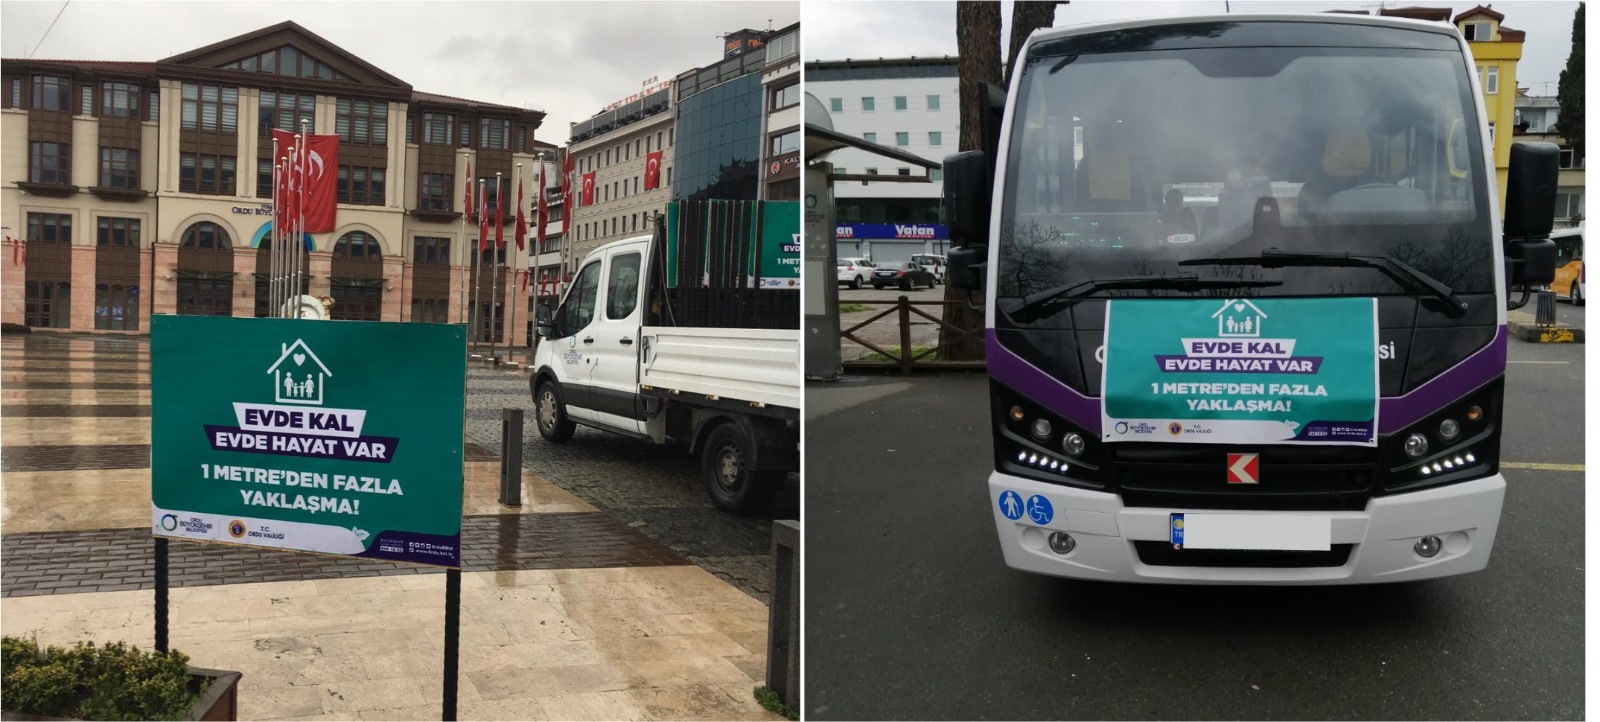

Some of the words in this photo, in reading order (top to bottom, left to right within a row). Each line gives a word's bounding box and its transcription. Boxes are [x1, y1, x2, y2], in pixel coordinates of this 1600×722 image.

[785, 157, 800, 165] KAL
[232, 206, 253, 215] ORDU
[836, 226, 853, 235] an
[895, 225, 935, 235] Vatan
[1192, 342, 1243, 354] EVDE
[1248, 342, 1286, 354] KAL
[1380, 341, 1395, 359] Sİ
[1165, 359, 1212, 370] EVDE
[1215, 359, 1273, 371] HAYAT
[1276, 360, 1313, 372] VAR
[1151, 383, 1159, 394] 1
[1163, 383, 1264, 395] METRE'DEN
[1269, 384, 1328, 396] FAZLA
[1186, 400, 1292, 413] YAKLAŞMA!
[245, 408, 303, 429] EVDE
[309, 412, 354, 432] KAL
[216, 431, 268, 450] EVDE
[272, 435, 338, 455] HAYAT
[342, 440, 386, 459] VAR
[201, 464, 209, 479] 1
[214, 464, 328, 489] METRE'DEN
[333, 474, 404, 496] FAZLA
[240, 489, 360, 515] YAKLAŞMA!
[263, 532, 285, 540] VALİLİĞİ
